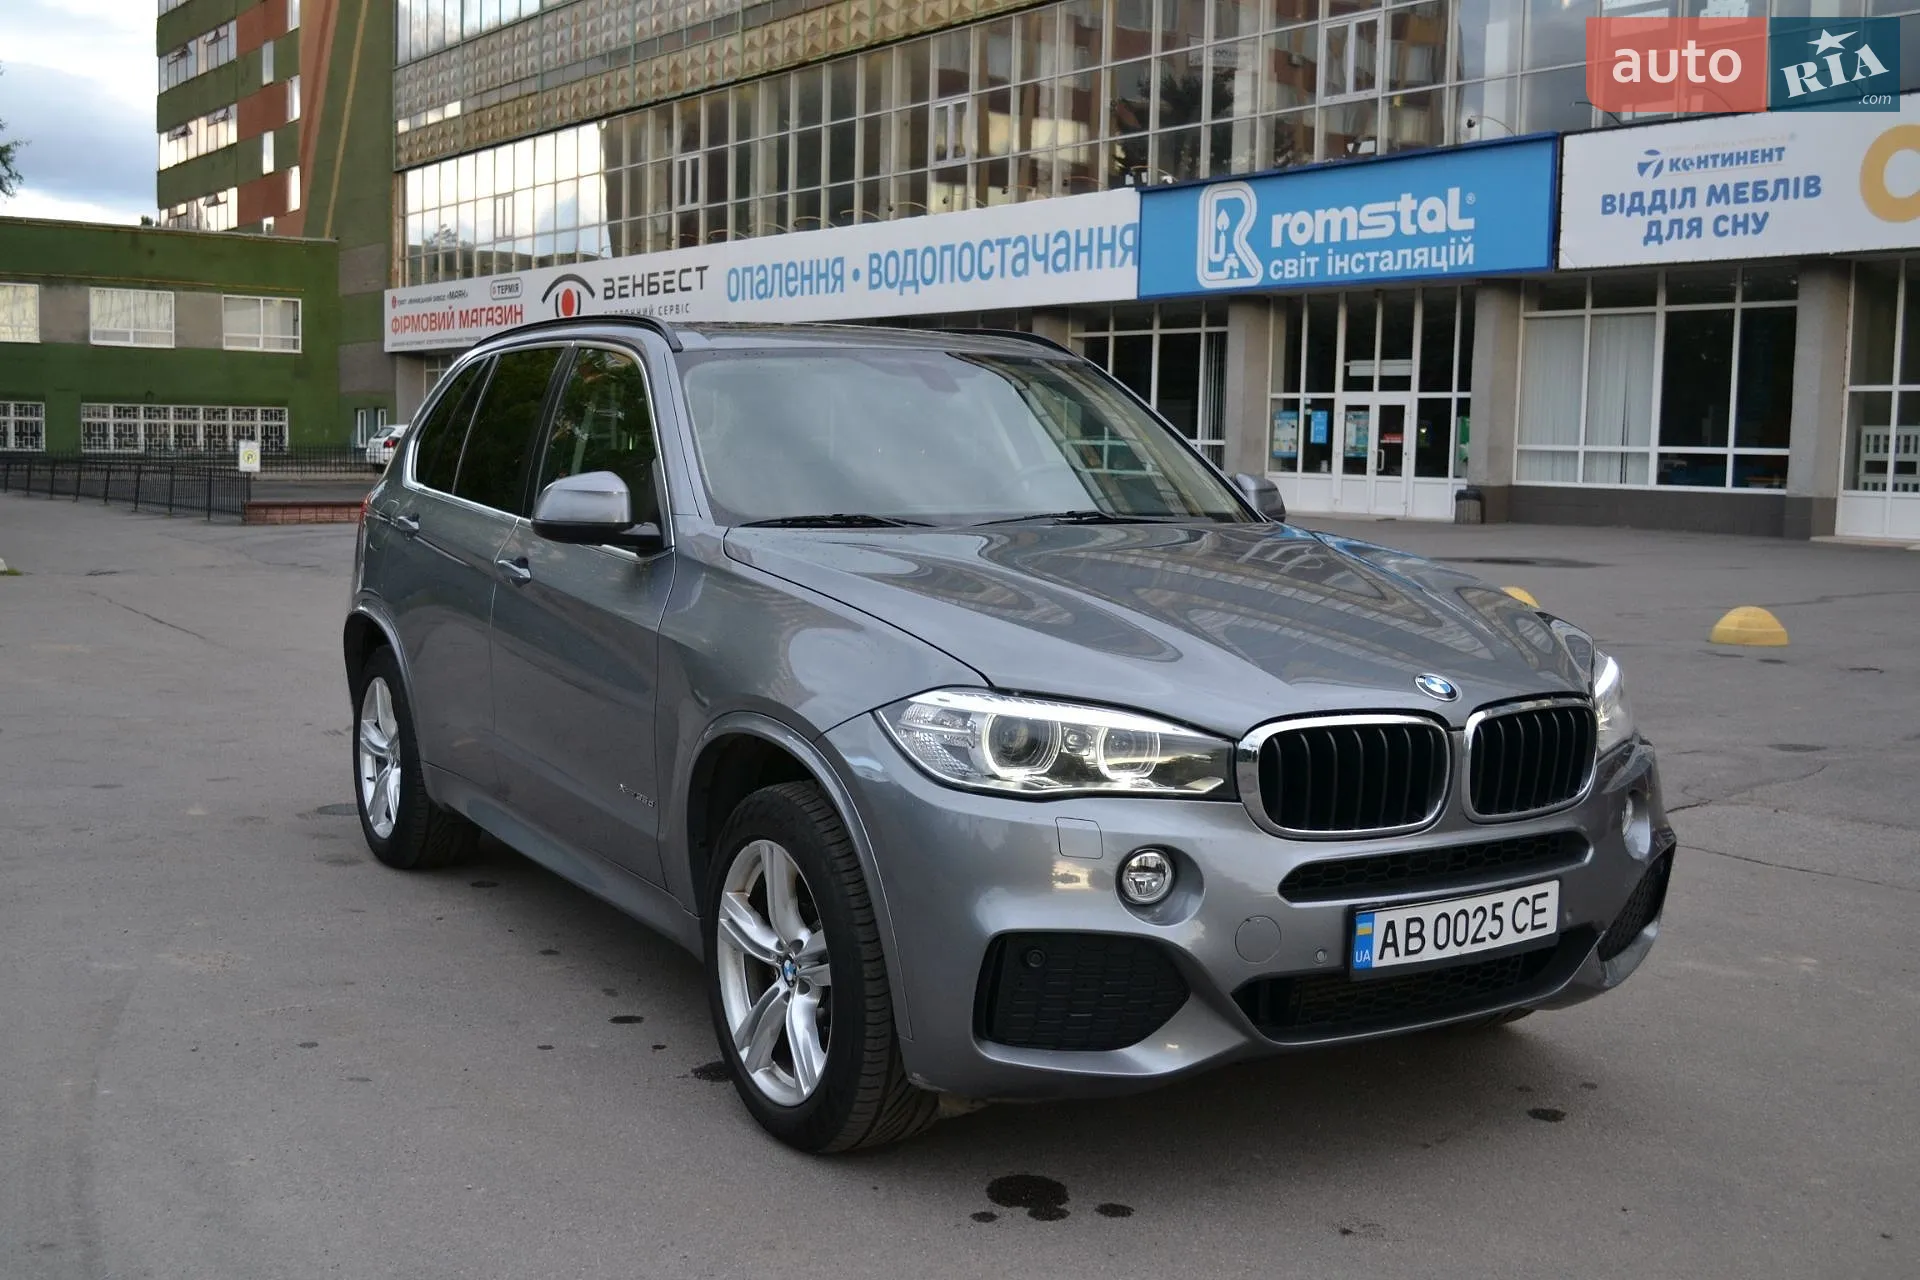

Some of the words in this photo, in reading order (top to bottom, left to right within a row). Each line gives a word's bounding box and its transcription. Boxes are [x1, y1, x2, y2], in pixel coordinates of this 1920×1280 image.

[1600, 186, 1697, 218] ВІДДІЛ
[1705, 174, 1822, 207] МЕБЛІВ
[1642, 217, 1703, 247] ДЛЯ
[1712, 211, 1770, 237] СНУ
[727, 256, 845, 303] опалення
[868, 221, 1138, 296] водопостачання
[1269, 254, 1320, 281] світ
[1327, 236, 1475, 276] інсталяцій
[602, 265, 710, 301] ВЕНБЕСТ
[391, 305, 456, 336] ФІРМОВИЙ
[460, 304, 524, 329] МАГАЗИН
[658, 303, 691, 316] СЕРВІС
[1354, 949, 1371, 964] UA
